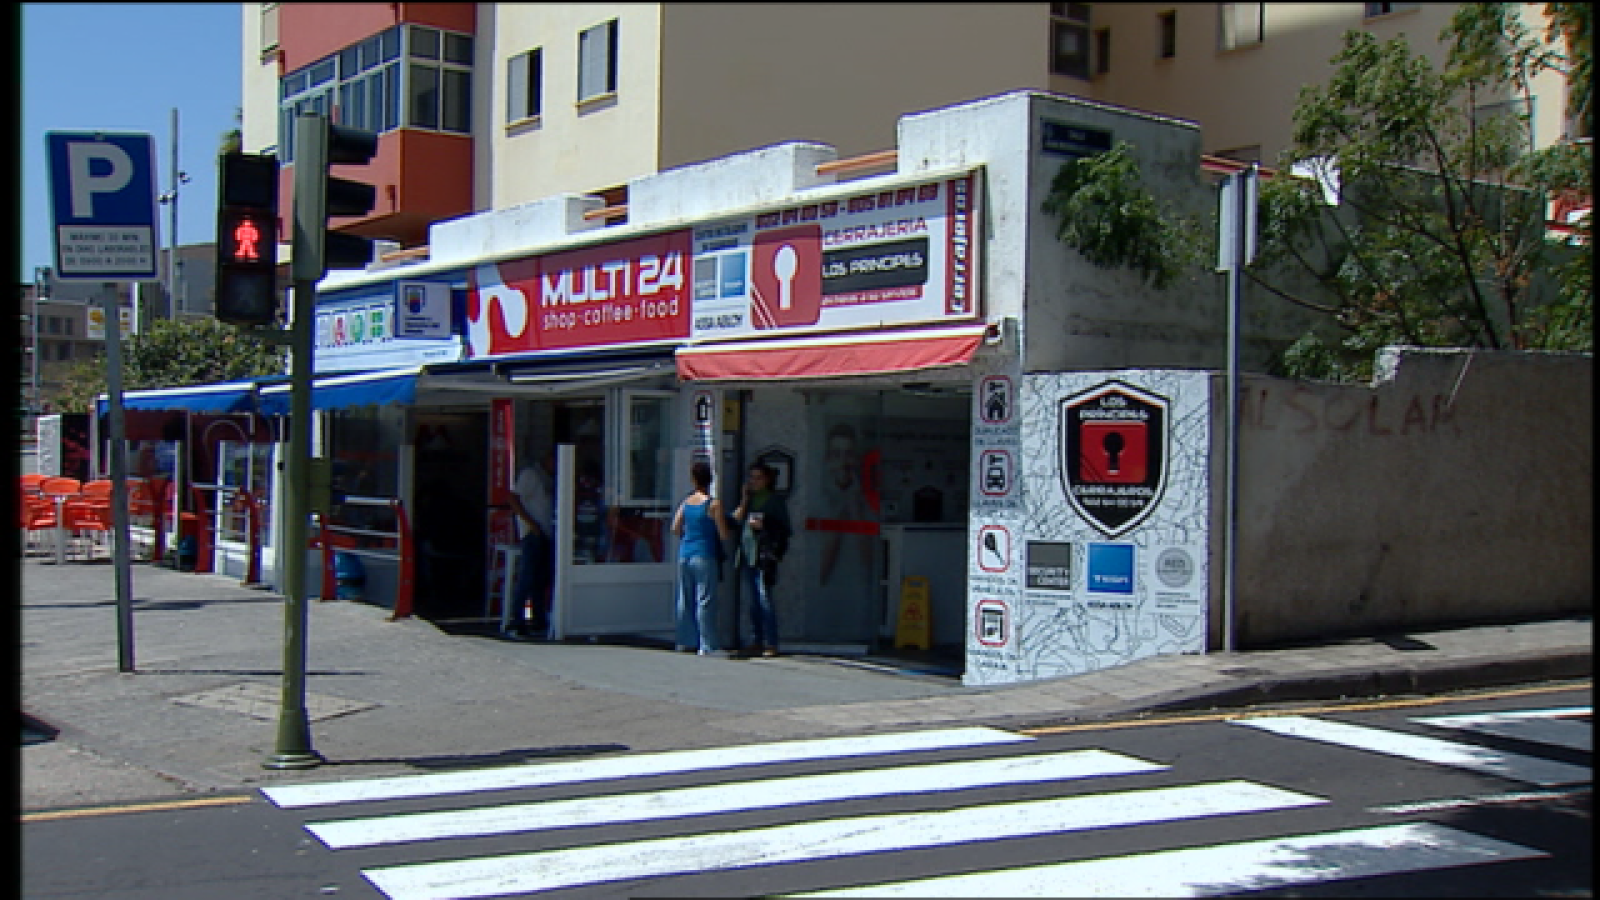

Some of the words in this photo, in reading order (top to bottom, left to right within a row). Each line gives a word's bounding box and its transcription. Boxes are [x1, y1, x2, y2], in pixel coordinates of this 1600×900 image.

[67, 142, 133, 218] P
[824, 217, 928, 245] CERRAJERIA
[541, 259, 631, 307] MULTI
[638, 250, 684, 296] 24
[823, 258, 847, 277] LOS
[1099, 396, 1128, 407] LOS
